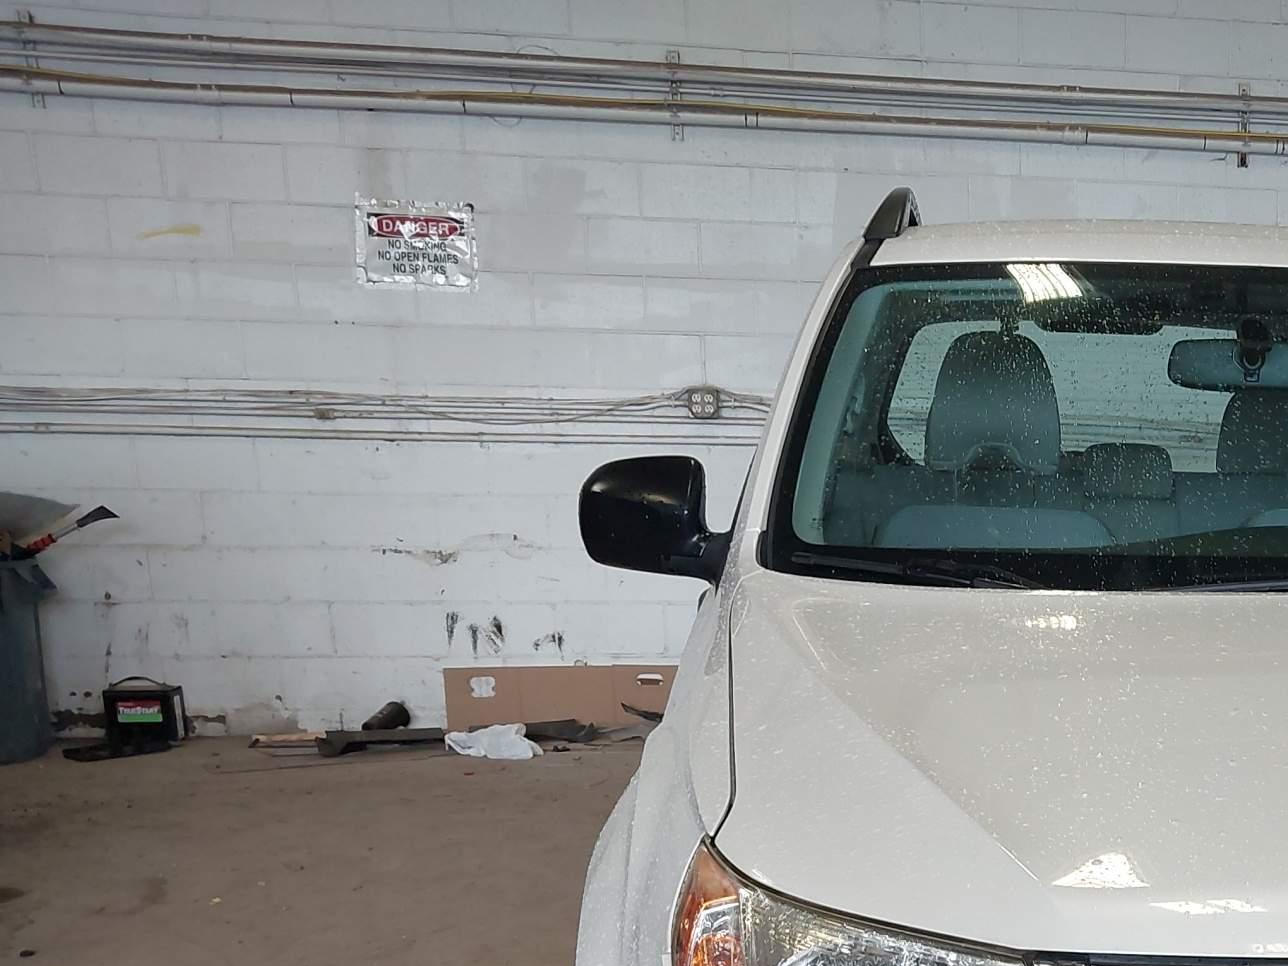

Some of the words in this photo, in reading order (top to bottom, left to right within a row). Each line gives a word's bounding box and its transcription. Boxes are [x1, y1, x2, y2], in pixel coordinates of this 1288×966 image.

[382, 220, 450, 235] DANGER
[388, 239, 402, 250] NO
[378, 250, 392, 261] NO
[394, 251, 420, 262] OPEN
[422, 252, 459, 264] FLAMES
[393, 263, 407, 274] NO
[409, 264, 447, 275] SPARKS
